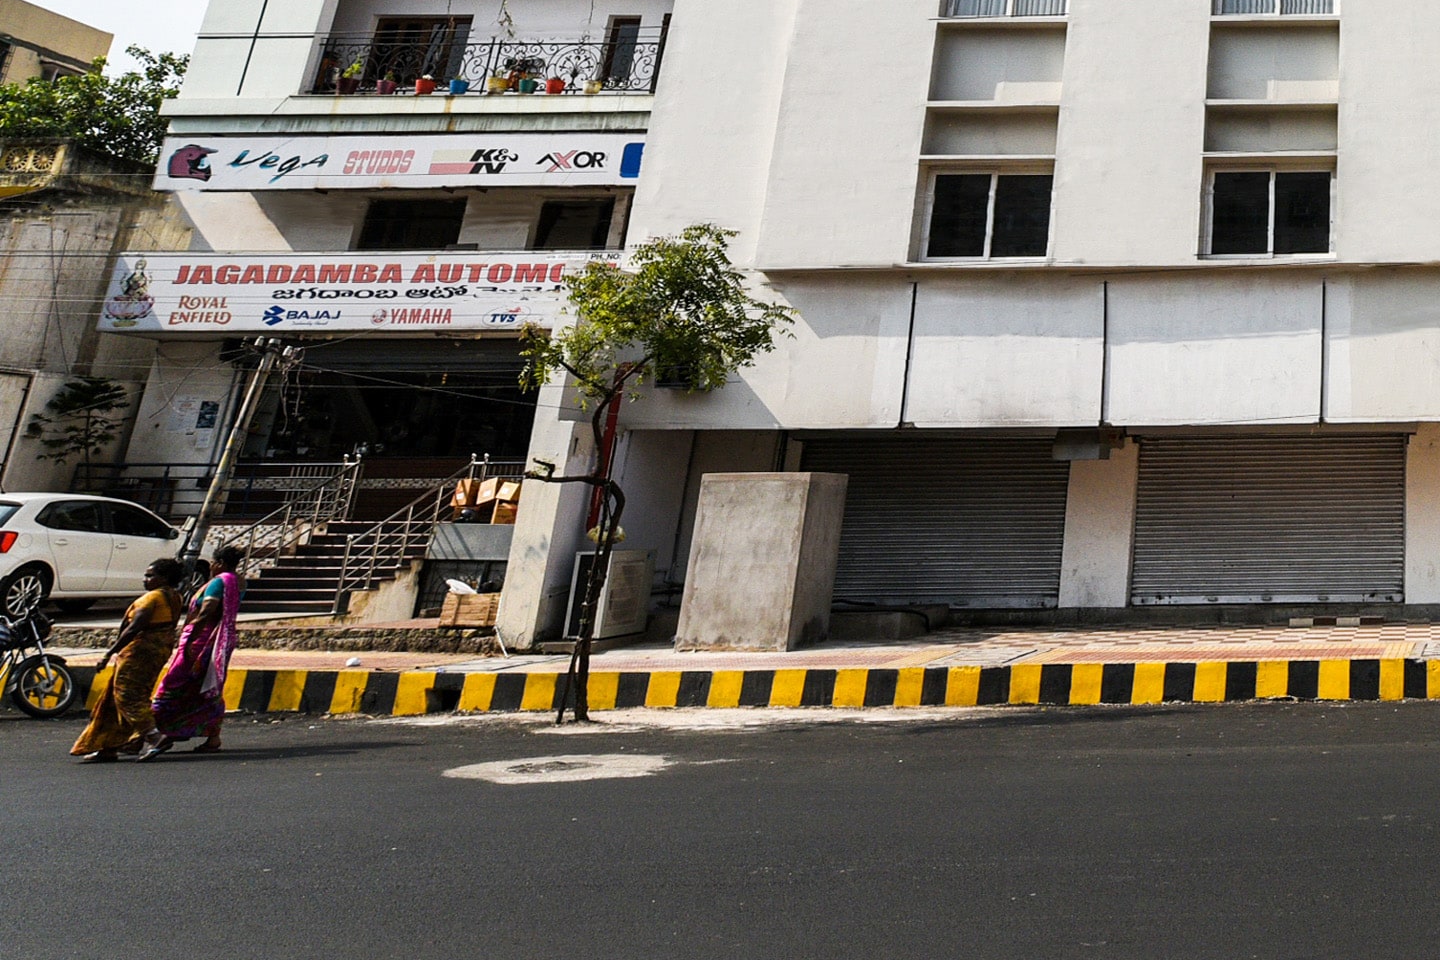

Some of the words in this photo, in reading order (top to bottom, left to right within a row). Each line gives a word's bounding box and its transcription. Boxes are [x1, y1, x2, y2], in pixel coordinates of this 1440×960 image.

[342, 150, 416, 174] STUDDS
[535, 149, 606, 173] AXOR
[171, 263, 407, 285] JAGADAMBA
[271, 286, 398, 300] జగదాంబ
[178, 295, 229, 310] ROYAL
[167, 310, 233, 326] ENFIELD
[286, 310, 342, 320] BAJAJ
[390, 308, 452, 325] YAMAHA
[489, 313, 518, 324] TVS
